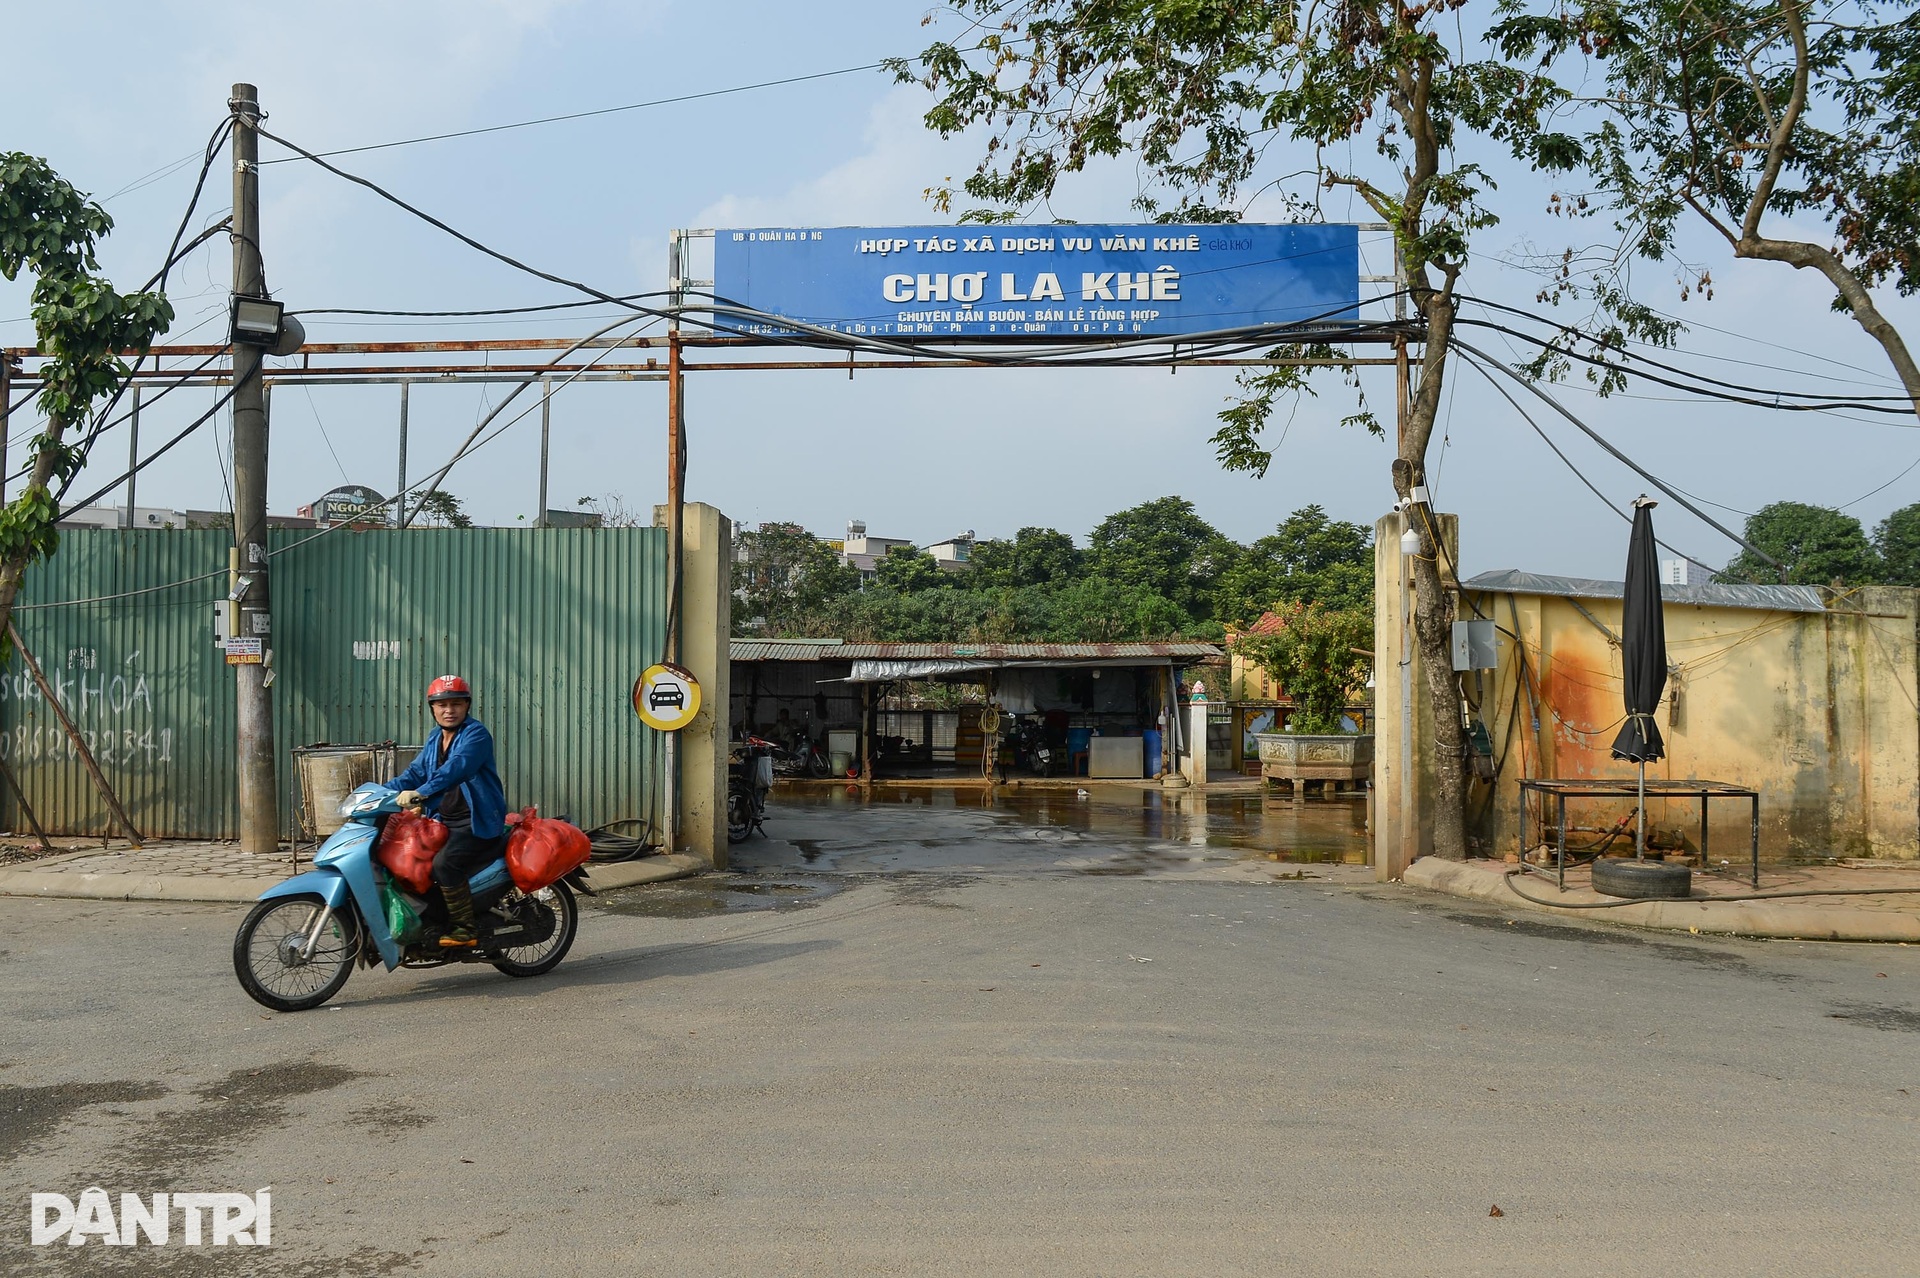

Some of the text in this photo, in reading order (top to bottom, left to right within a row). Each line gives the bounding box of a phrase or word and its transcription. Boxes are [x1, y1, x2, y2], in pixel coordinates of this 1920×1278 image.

[861, 238, 909, 256] HỢP
[913, 235, 957, 253] TÁC
[962, 235, 996, 253] XÃ
[1001, 238, 1055, 255] DỊCH
[1099, 234, 1146, 252] VĂN
[1153, 234, 1201, 252] KHÊ
[883, 264, 1181, 310] CHỢ LA KHÊ
[898, 309, 951, 323] CHUYÊN
[988, 309, 1026, 322] BUÔN
[1034, 308, 1063, 321] BÁN
[1068, 306, 1085, 321] LẺ
[1089, 305, 1126, 321] TỔNG
[1130, 309, 1160, 324] HỢP
